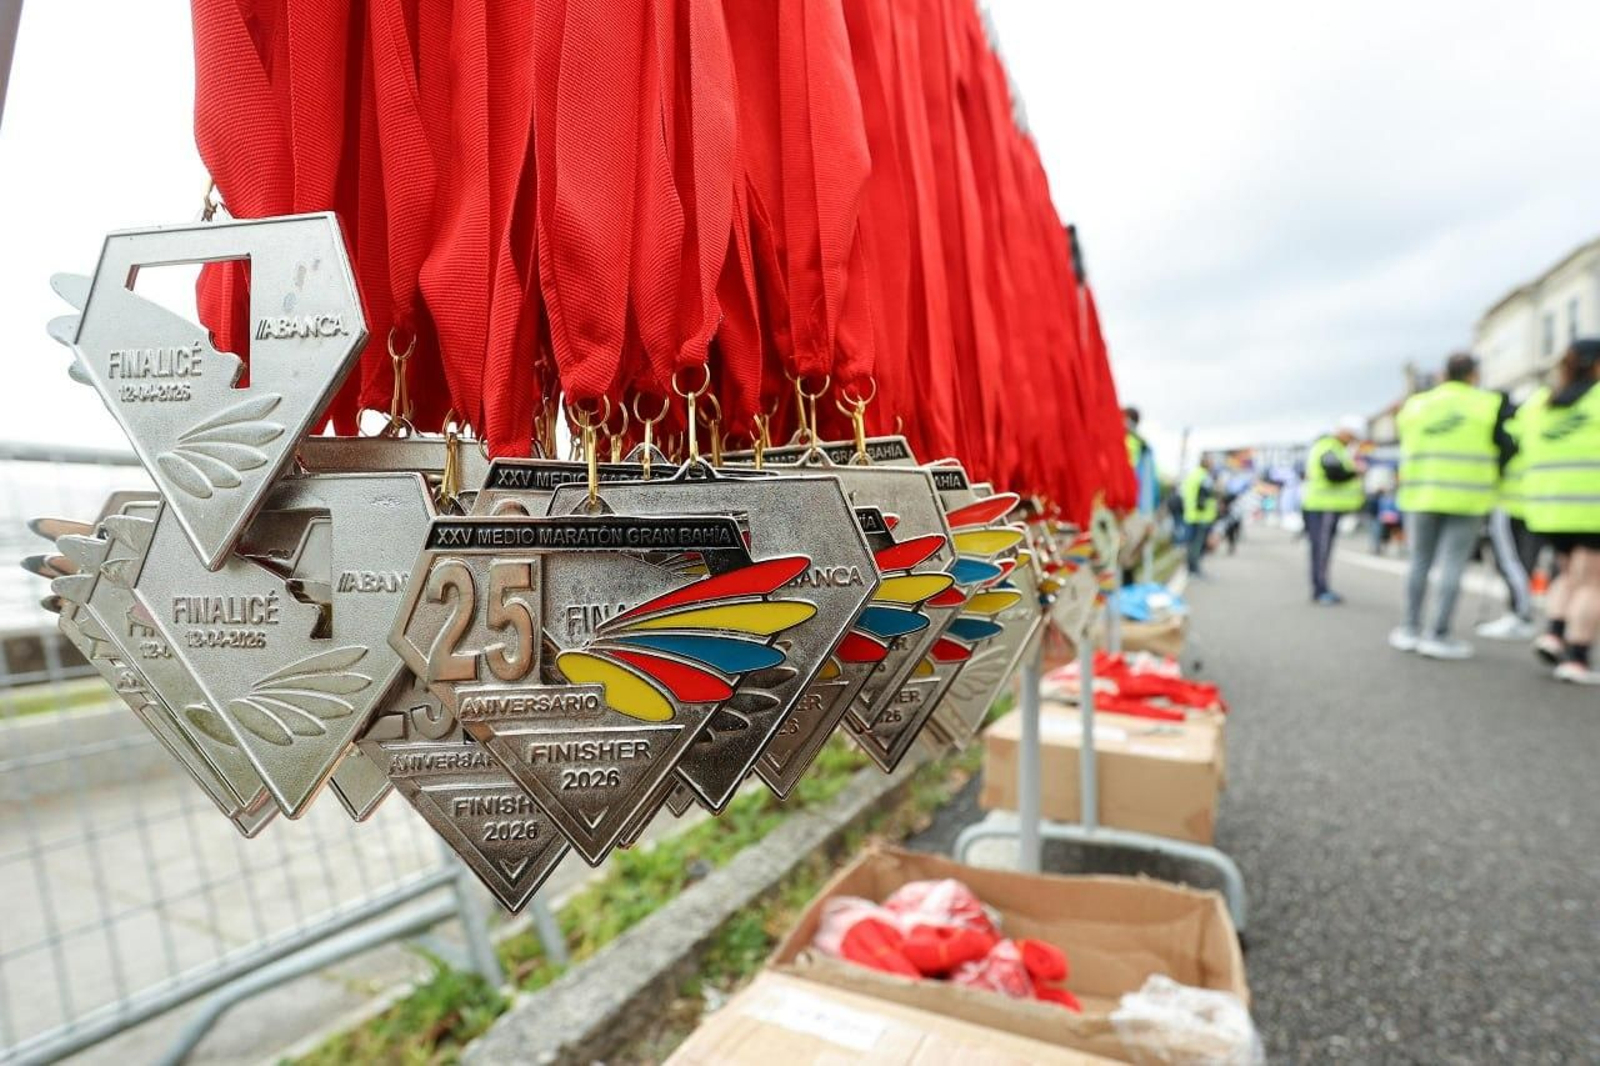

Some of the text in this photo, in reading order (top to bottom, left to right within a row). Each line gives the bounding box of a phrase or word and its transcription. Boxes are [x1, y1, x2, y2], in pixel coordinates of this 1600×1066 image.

[108, 340, 202, 379] FINALICÉ
[498, 469, 533, 487] XXV
[437, 525, 731, 545] XXV MEDIO MARATÓN GRAN BAHÍA
[171, 590, 280, 625] FINALICÉ
[424, 556, 537, 682] 25
[459, 694, 599, 720] ANIVERSARIO
[528, 739, 653, 766] FINISHER
[560, 766, 621, 791] 2026
[453, 795, 540, 816] FINISH
[482, 820, 540, 841] 2026
